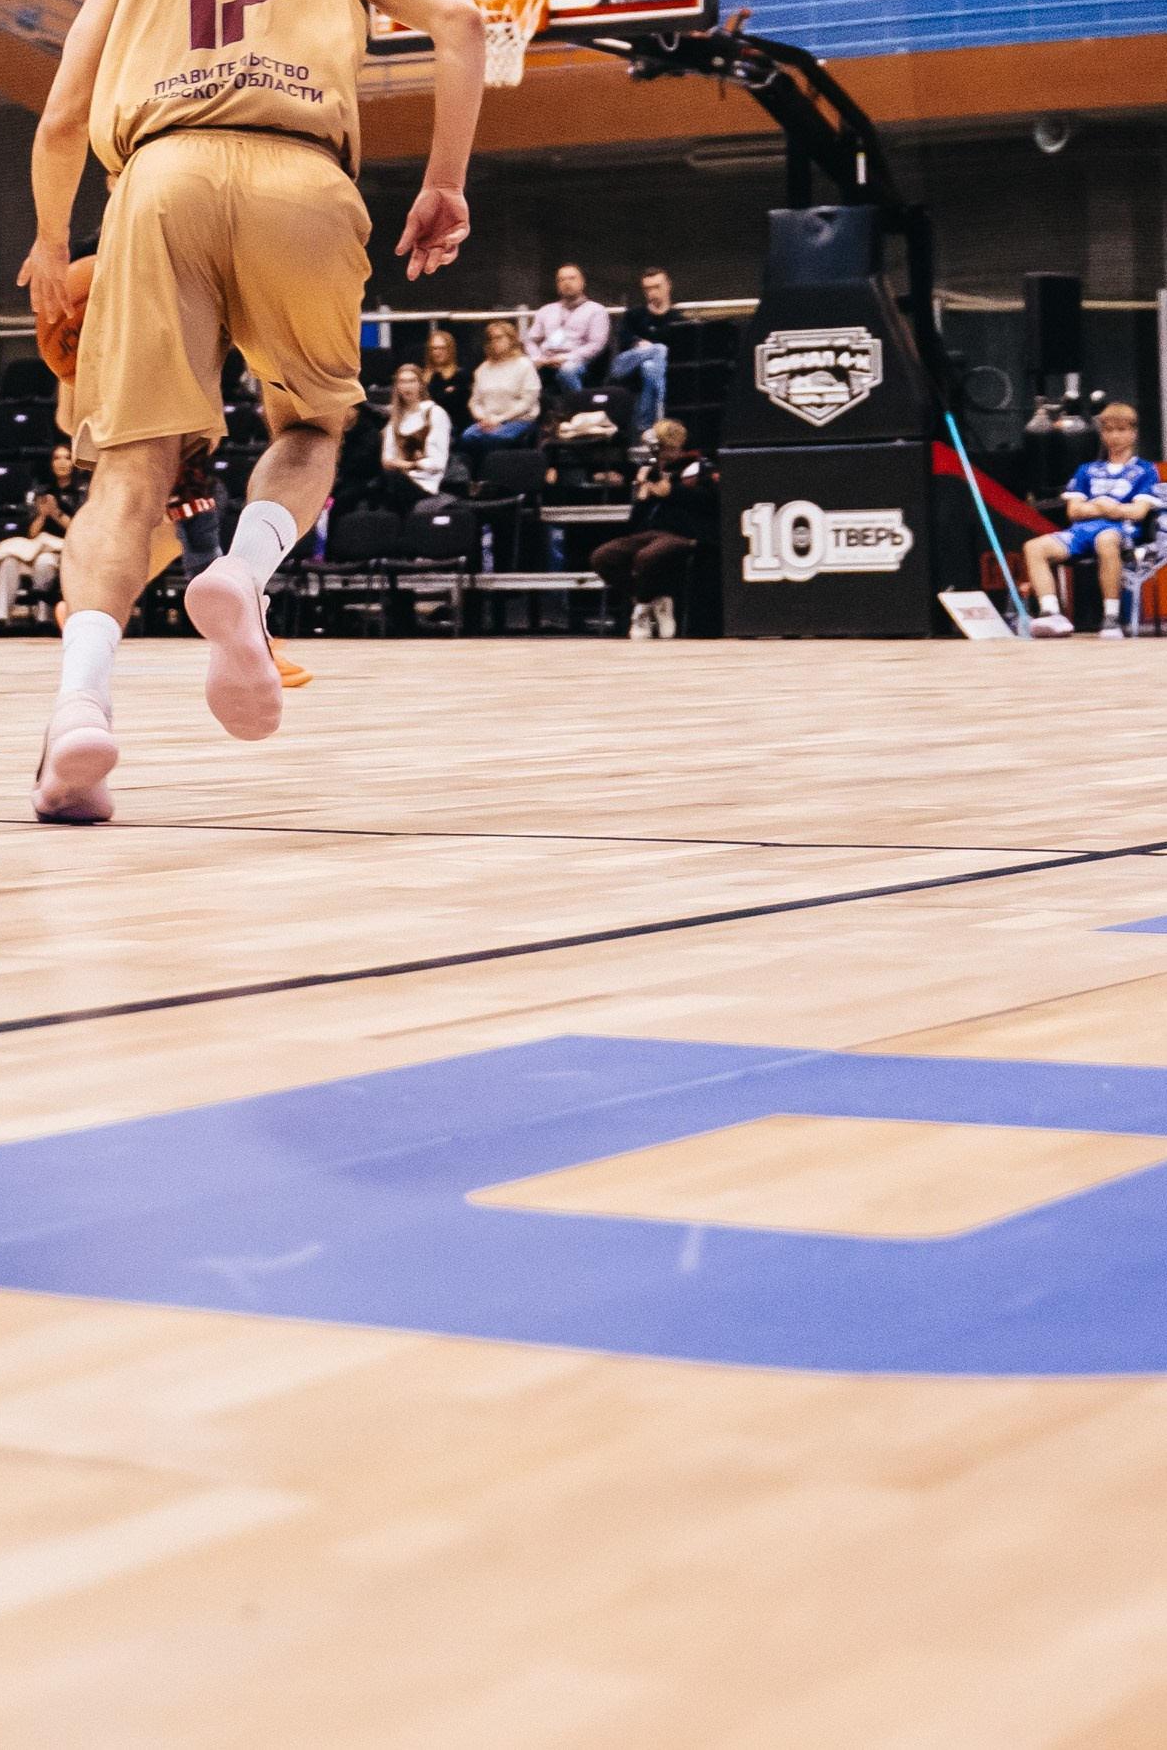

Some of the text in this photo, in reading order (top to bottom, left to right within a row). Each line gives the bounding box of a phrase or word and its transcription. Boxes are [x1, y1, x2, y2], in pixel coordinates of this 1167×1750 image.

[234, 71, 324, 104] ОБЛАСТИ
[746, 500, 825, 574] 10
[832, 526, 905, 548] ТВЕРЬ
